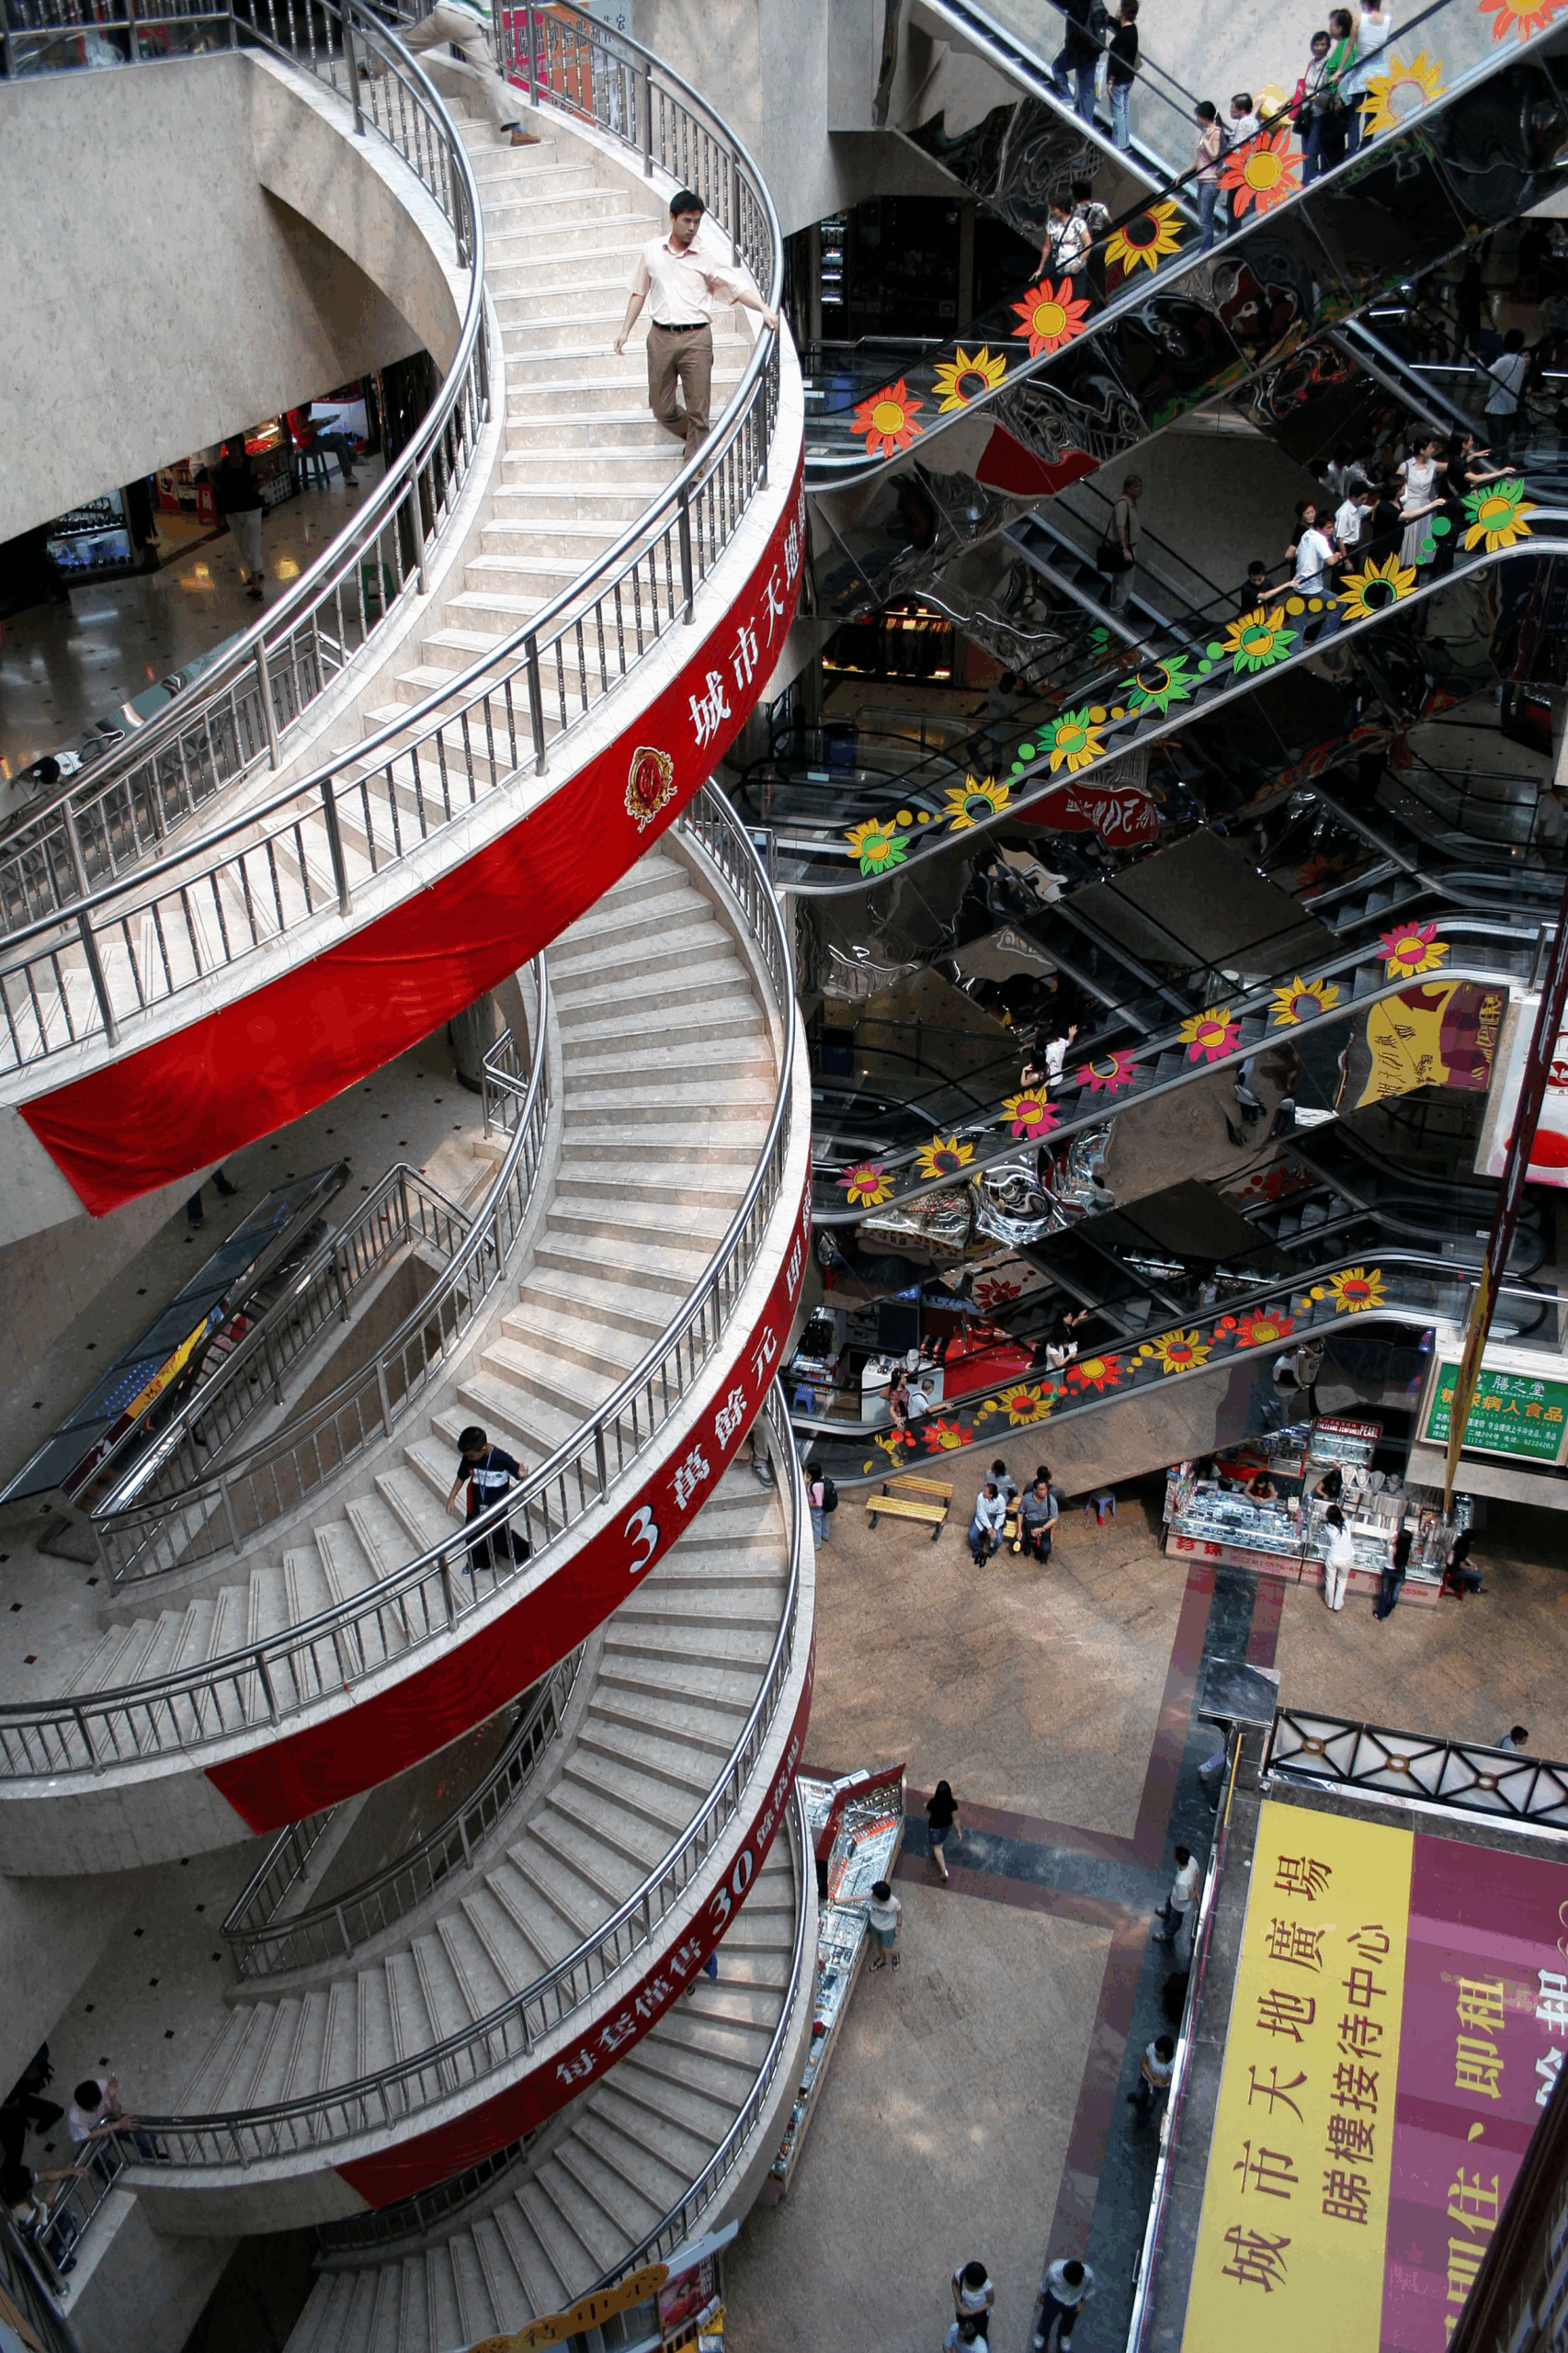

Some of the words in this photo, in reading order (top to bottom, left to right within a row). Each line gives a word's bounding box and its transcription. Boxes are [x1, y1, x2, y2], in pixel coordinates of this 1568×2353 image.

[1359, 1425, 1379, 1439] PEARL
[1222, 1854, 1333, 2293] 城市天地廣場
[1322, 1923, 1392, 2225] 睇樓接待中心
